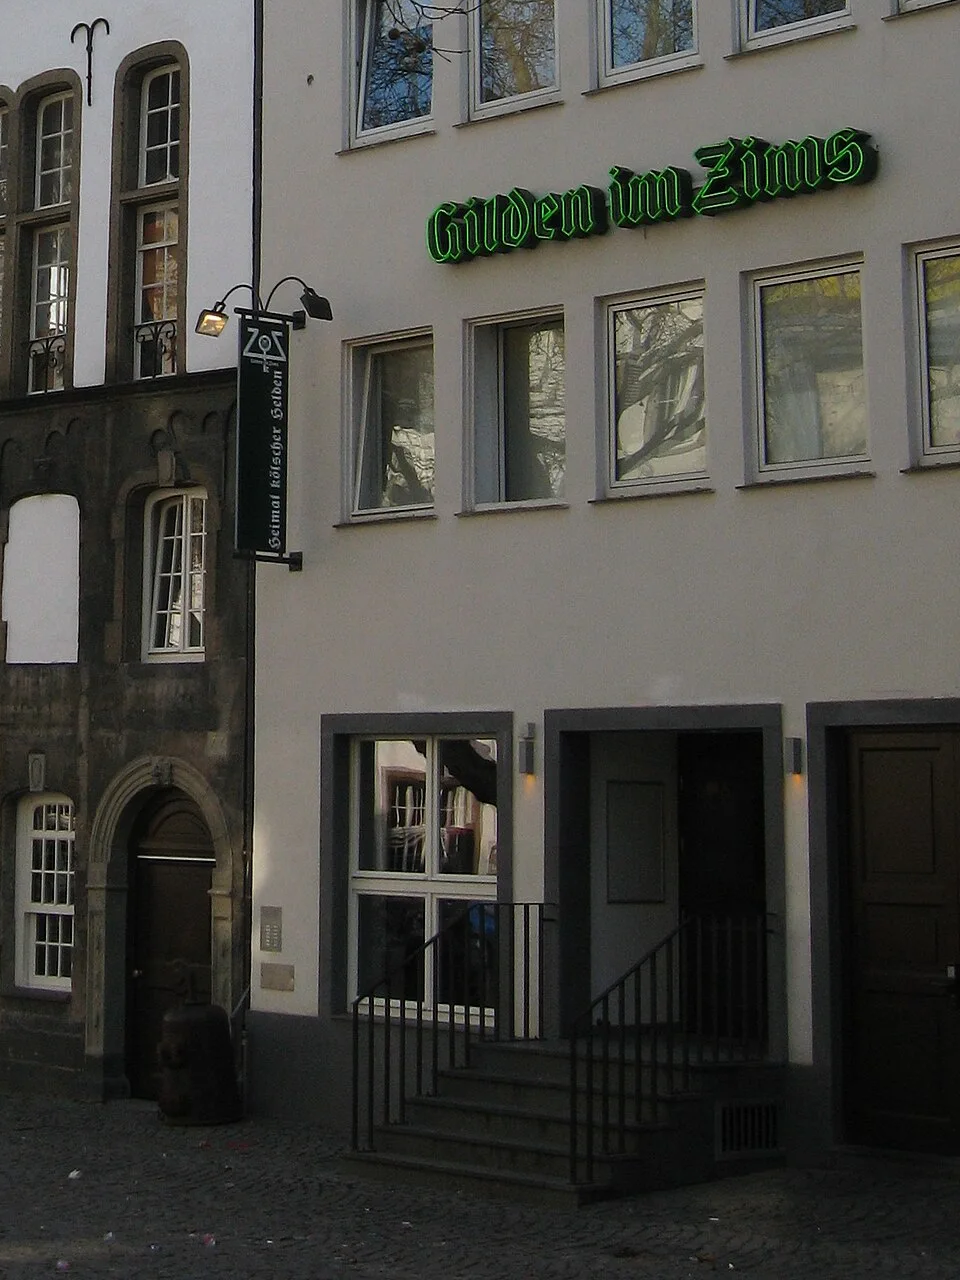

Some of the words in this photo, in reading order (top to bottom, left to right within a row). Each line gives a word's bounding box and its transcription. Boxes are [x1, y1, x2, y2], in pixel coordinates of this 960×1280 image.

[426, 185, 607, 264] Gilden
[606, 165, 693, 229] im
[692, 127, 879, 216] Zims
[271, 371, 283, 420] Helden
[270, 426, 283, 488] kölscher
